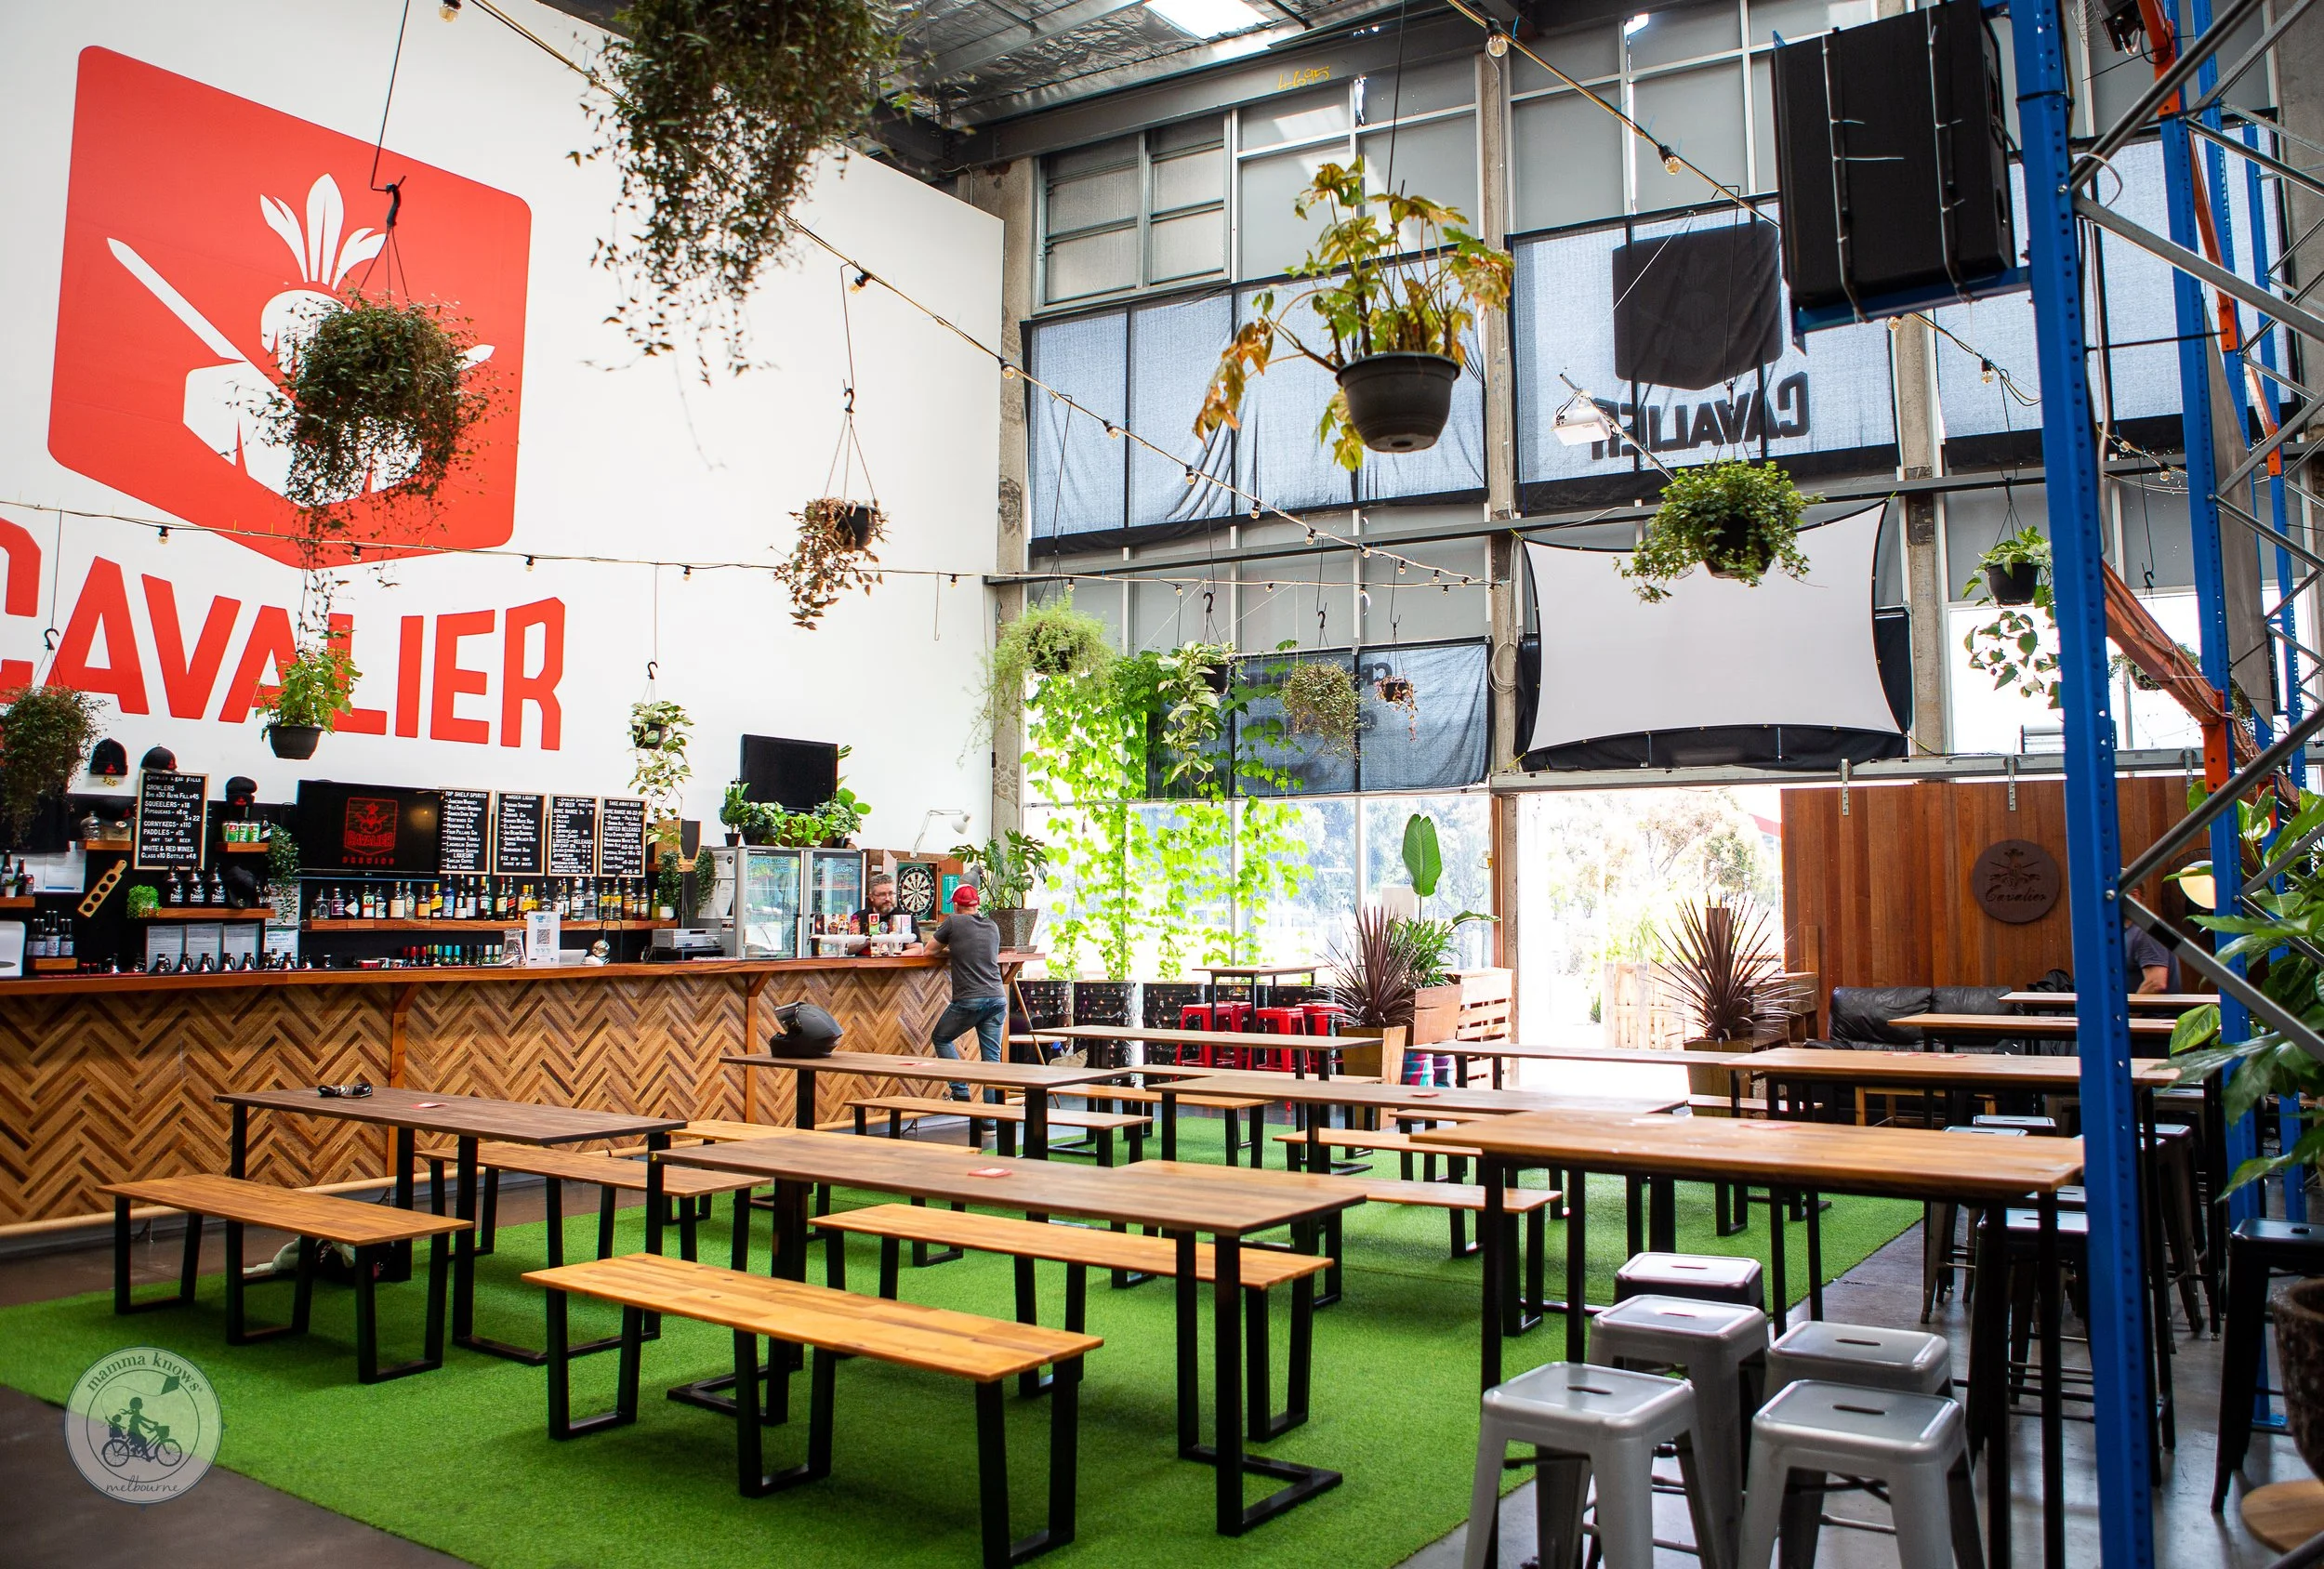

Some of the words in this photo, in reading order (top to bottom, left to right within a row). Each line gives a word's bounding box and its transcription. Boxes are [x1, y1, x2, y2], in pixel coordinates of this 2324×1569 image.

[1277, 65, 1330, 90] 4695
[103, 775, 117, 787] $25
[1985, 884, 2047, 903] Cavalier
